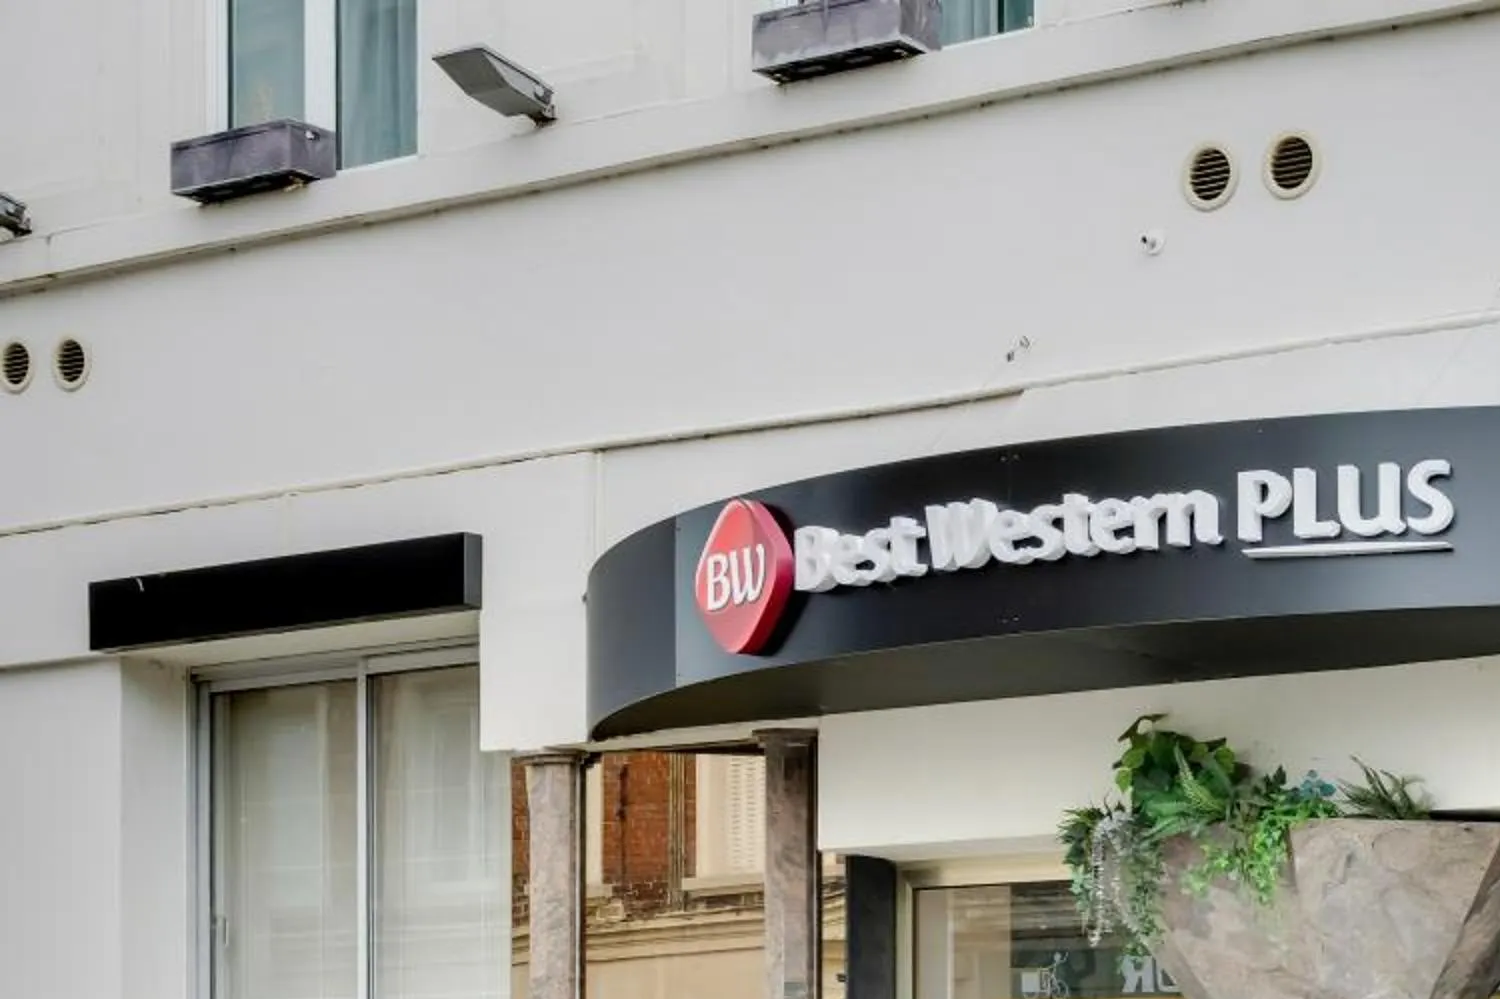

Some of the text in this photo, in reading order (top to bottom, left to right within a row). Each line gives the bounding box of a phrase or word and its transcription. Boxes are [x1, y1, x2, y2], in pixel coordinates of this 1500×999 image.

[794, 459, 1455, 592] Best Western PLUS
[706, 543, 765, 612] BW
